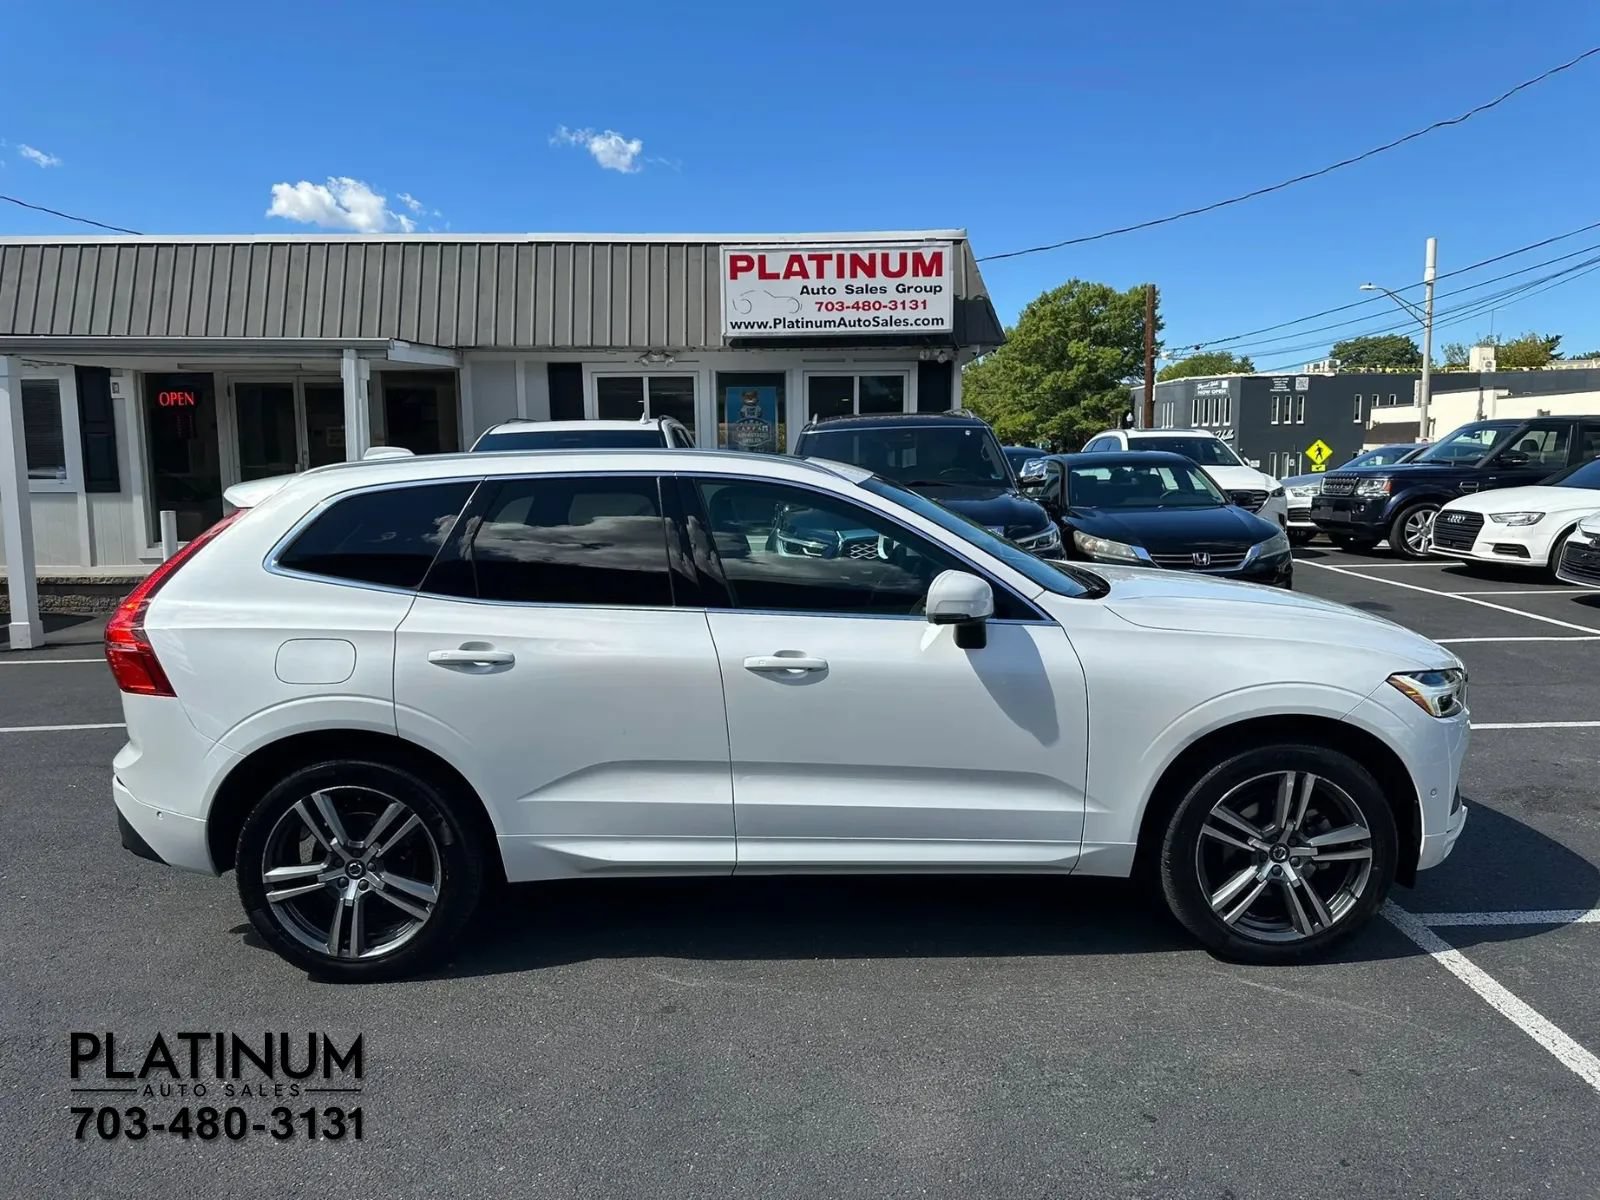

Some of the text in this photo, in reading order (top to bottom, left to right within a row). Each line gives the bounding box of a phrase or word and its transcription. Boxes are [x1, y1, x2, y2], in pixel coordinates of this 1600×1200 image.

[729, 251, 943, 280] PLATINUM
[800, 283, 943, 296] Auto Sales Group
[815, 299, 928, 312] 703-480-3131
[729, 316, 945, 330] www.PlatinumAutoSales.com
[159, 391, 194, 407] OPEN
